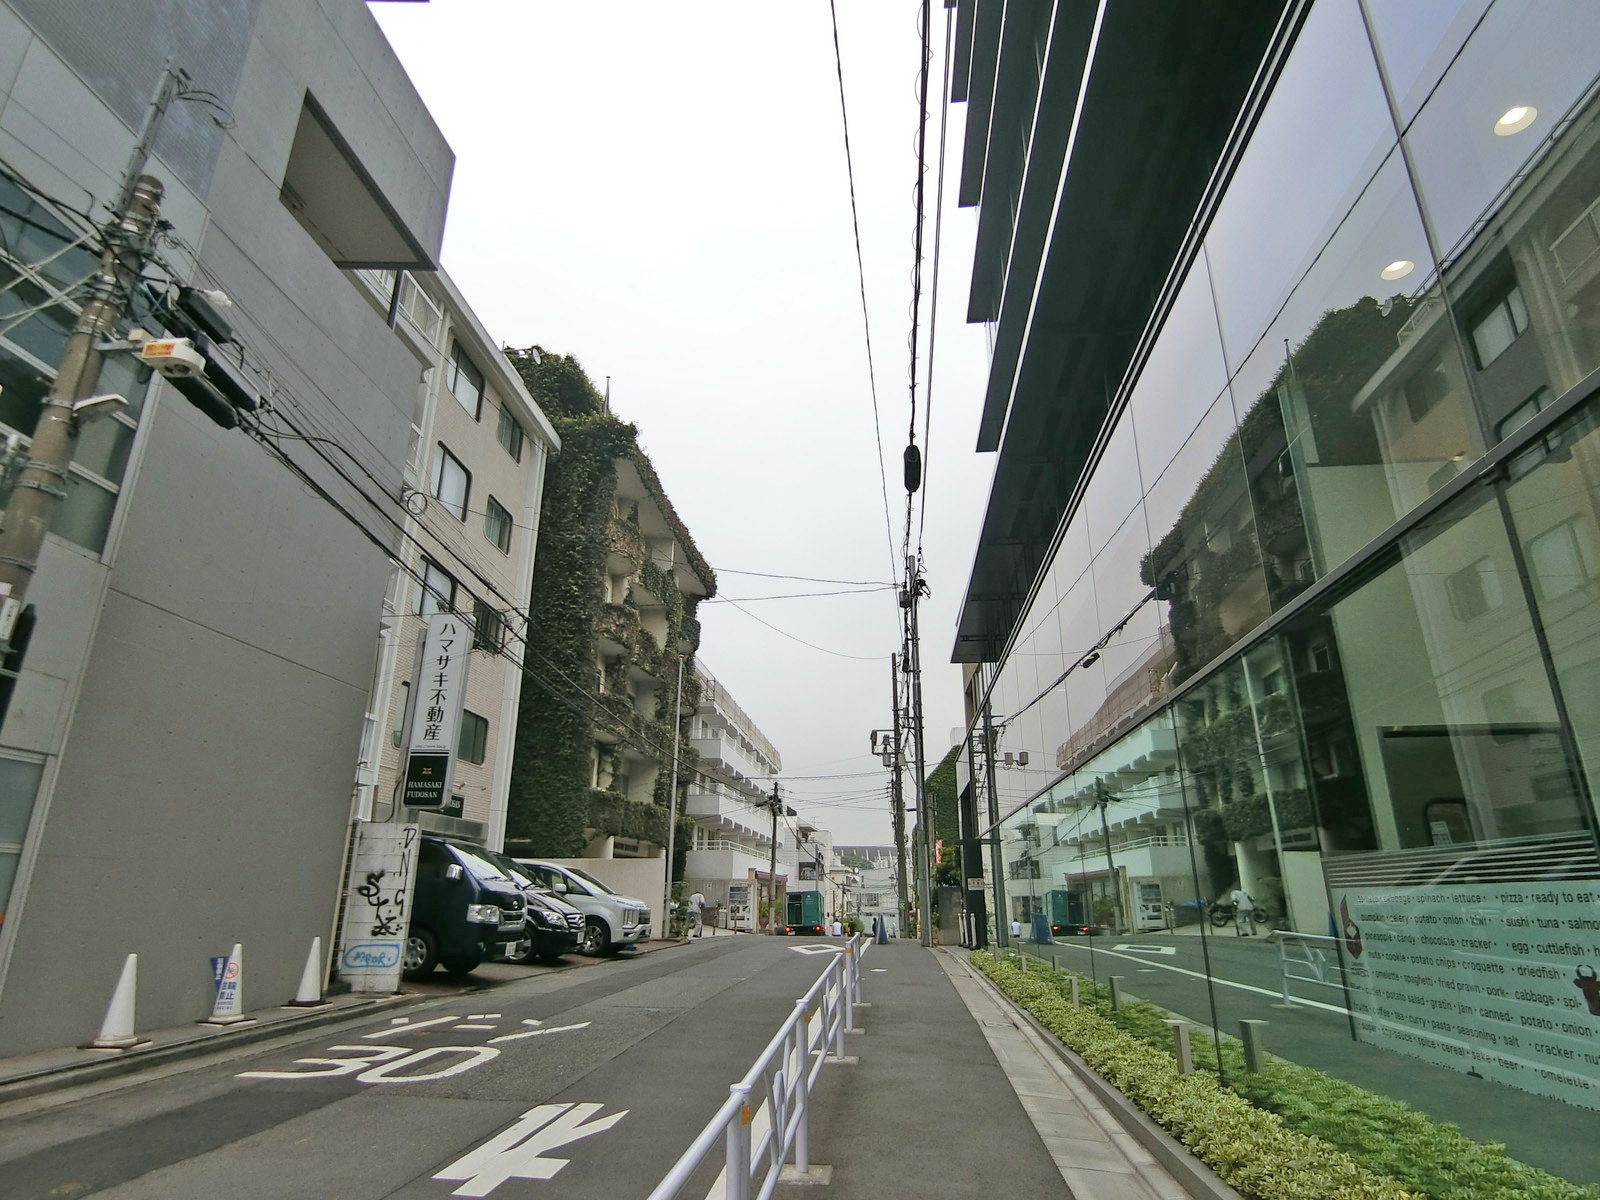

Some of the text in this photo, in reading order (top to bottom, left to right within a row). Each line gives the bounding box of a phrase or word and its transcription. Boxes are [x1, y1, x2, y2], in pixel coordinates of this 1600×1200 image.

[423, 623, 456, 741] ハマサキ不動産
[408, 781, 442, 789] HAMASAKI
[406, 790, 438, 799] FUDOSAN
[1451, 893, 1481, 903] lettuce
[1500, 891, 1594, 905] pizza ready to eat
[1414, 915, 1437, 925] potato
[1443, 915, 1464, 925] onion
[1506, 916, 1600, 931] sushi tuna salmo
[1420, 934, 1455, 947] chocolate
[1461, 938, 1492, 950] cracker
[1511, 942, 1530, 955] egg
[1536, 941, 1585, 957] cuttlefish
[1385, 952, 1406, 962] cookie
[1410, 954, 1434, 966] potato
[1435, 957, 1456, 969] chips
[1462, 959, 1505, 974] croquette
[1517, 964, 1561, 980] driedfish
[1438, 977, 1455, 990] fried
[1456, 982, 1480, 995] prawn
[1514, 989, 1555, 1006] cabbage
[1430, 998, 1452, 1011] gratin
[1458, 1001, 1473, 1015] jam
[1394, 1010, 1405, 1021] tea
[1408, 1015, 1427, 1028] curry
[1431, 1019, 1452, 1033] pasta
[1456, 1025, 1497, 1045] seasoning
[1503, 1034, 1520, 1048] salt
[1520, 1014, 1593, 1038] potato onion
[1441, 1043, 1466, 1057] cereal
[1471, 1050, 1491, 1064] sake
[1497, 1056, 1519, 1071] beer
[1534, 1043, 1575, 1060] cracker
[234, 1044, 501, 1083] 30
[1540, 1068, 1591, 1091] omelette
